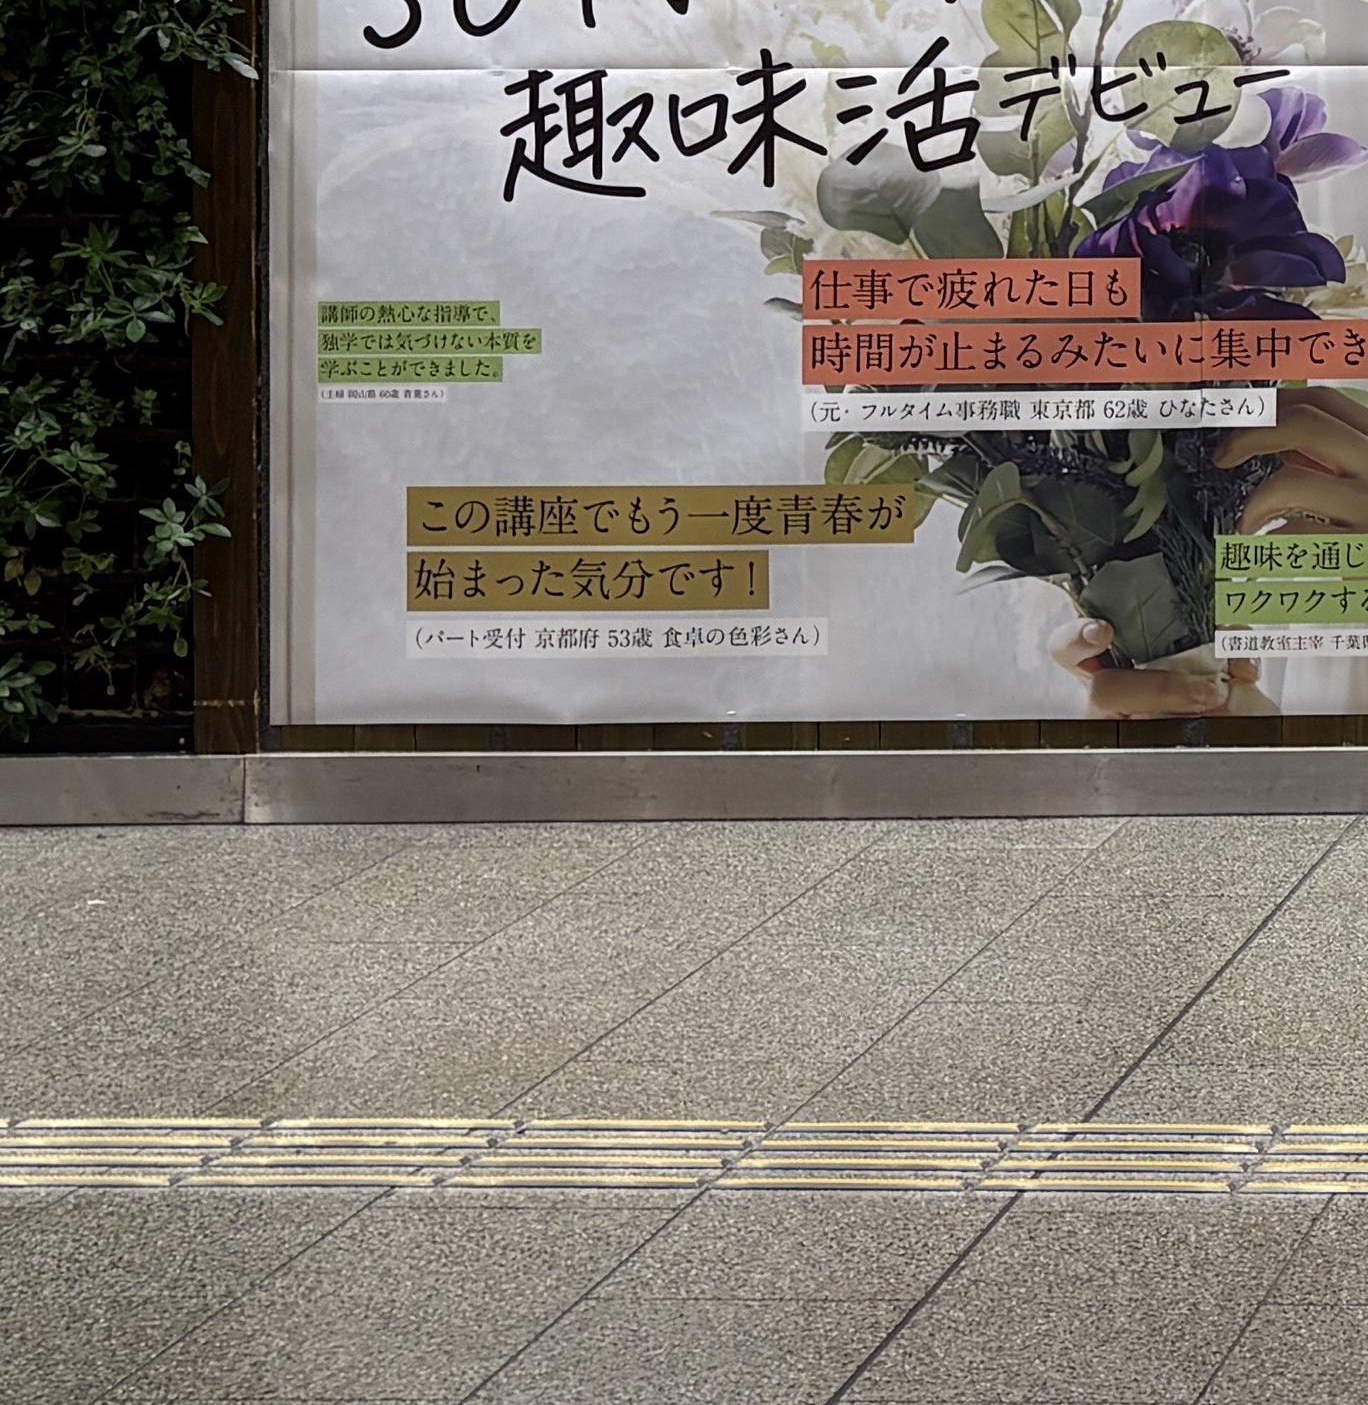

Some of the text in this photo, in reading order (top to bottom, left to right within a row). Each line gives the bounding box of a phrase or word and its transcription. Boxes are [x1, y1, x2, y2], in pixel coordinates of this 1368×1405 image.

[501, 36, 1290, 202] 趣味活デビュー
[810, 268, 1130, 309] 仕事で疲れた日も
[320, 305, 496, 323] 講師の熱心な指導で、
[322, 332, 536, 351] 独学では気づけない本質を
[321, 360, 499, 378] 学ぶことができました。
[1033, 397, 1094, 422] 東京都
[1103, 397, 1148, 420] 62歳
[1159, 396, 1265, 419] ひなたさん）
[422, 496, 903, 537] この講座でもう一度青春が
[415, 559, 756, 599] 始まった気分です！
[535, 628, 599, 649] 京都府
[607, 629, 653, 648] 53歳
